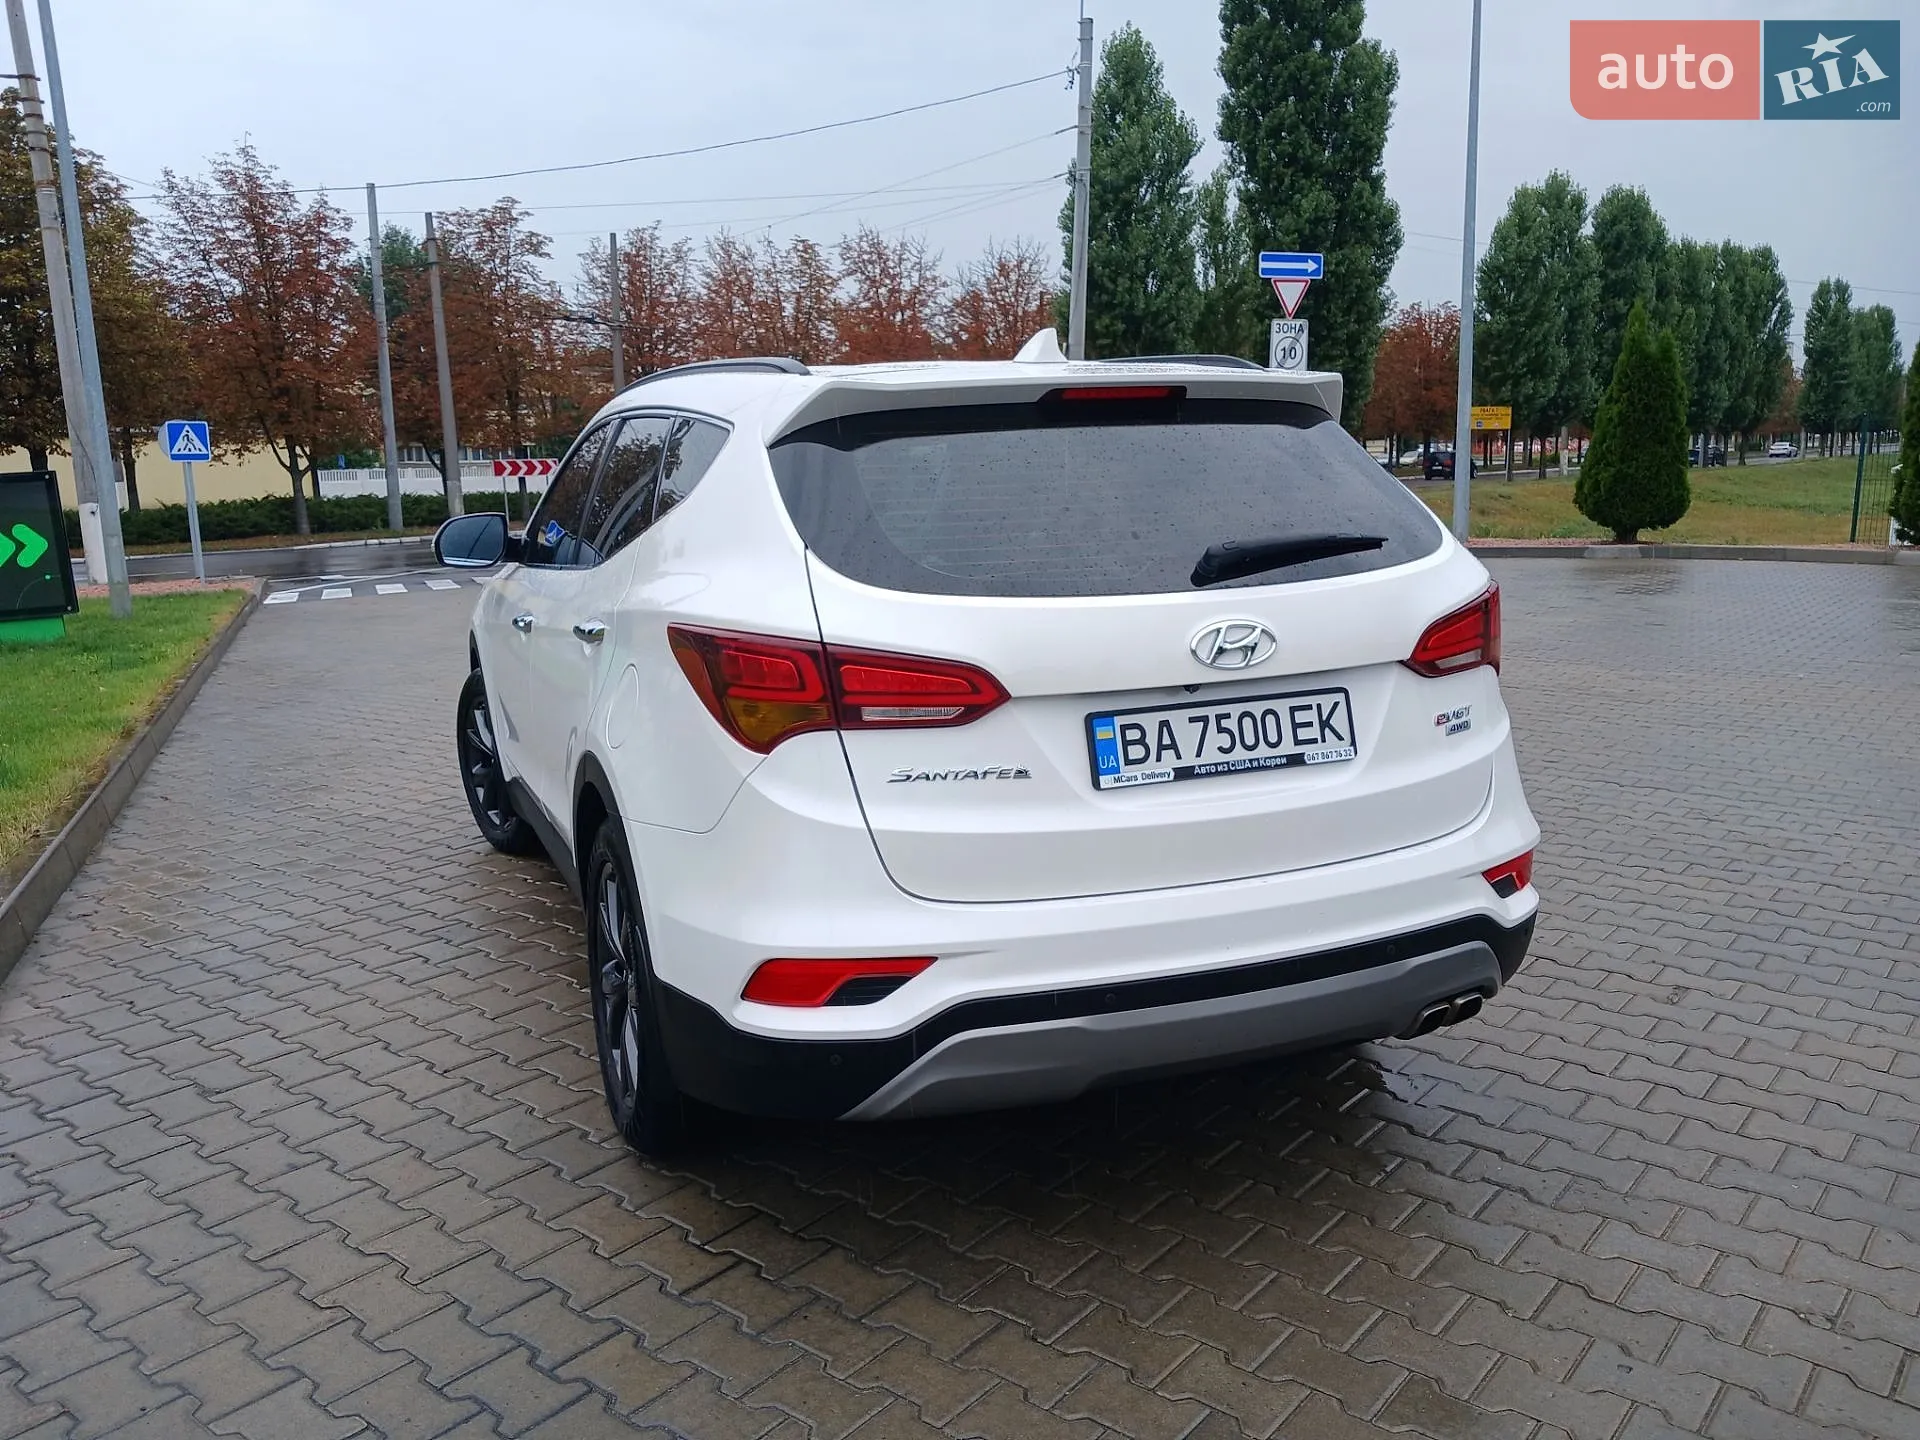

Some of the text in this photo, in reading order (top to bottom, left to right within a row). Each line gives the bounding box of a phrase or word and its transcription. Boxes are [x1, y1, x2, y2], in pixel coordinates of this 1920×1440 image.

[1275, 322, 1304, 334] ЗОНА
[1280, 346, 1297, 360] 10
[1449, 720, 1469, 732] 4WD
[1120, 701, 1345, 766] BA 7500 EK
[1099, 755, 1118, 769] UA
[1194, 765, 1216, 775] Авто
[1229, 761, 1251, 770] США
[1252, 760, 1258, 768] и
[1259, 757, 1287, 769] Кореи
[1113, 769, 1171, 784] MCars Delivery
